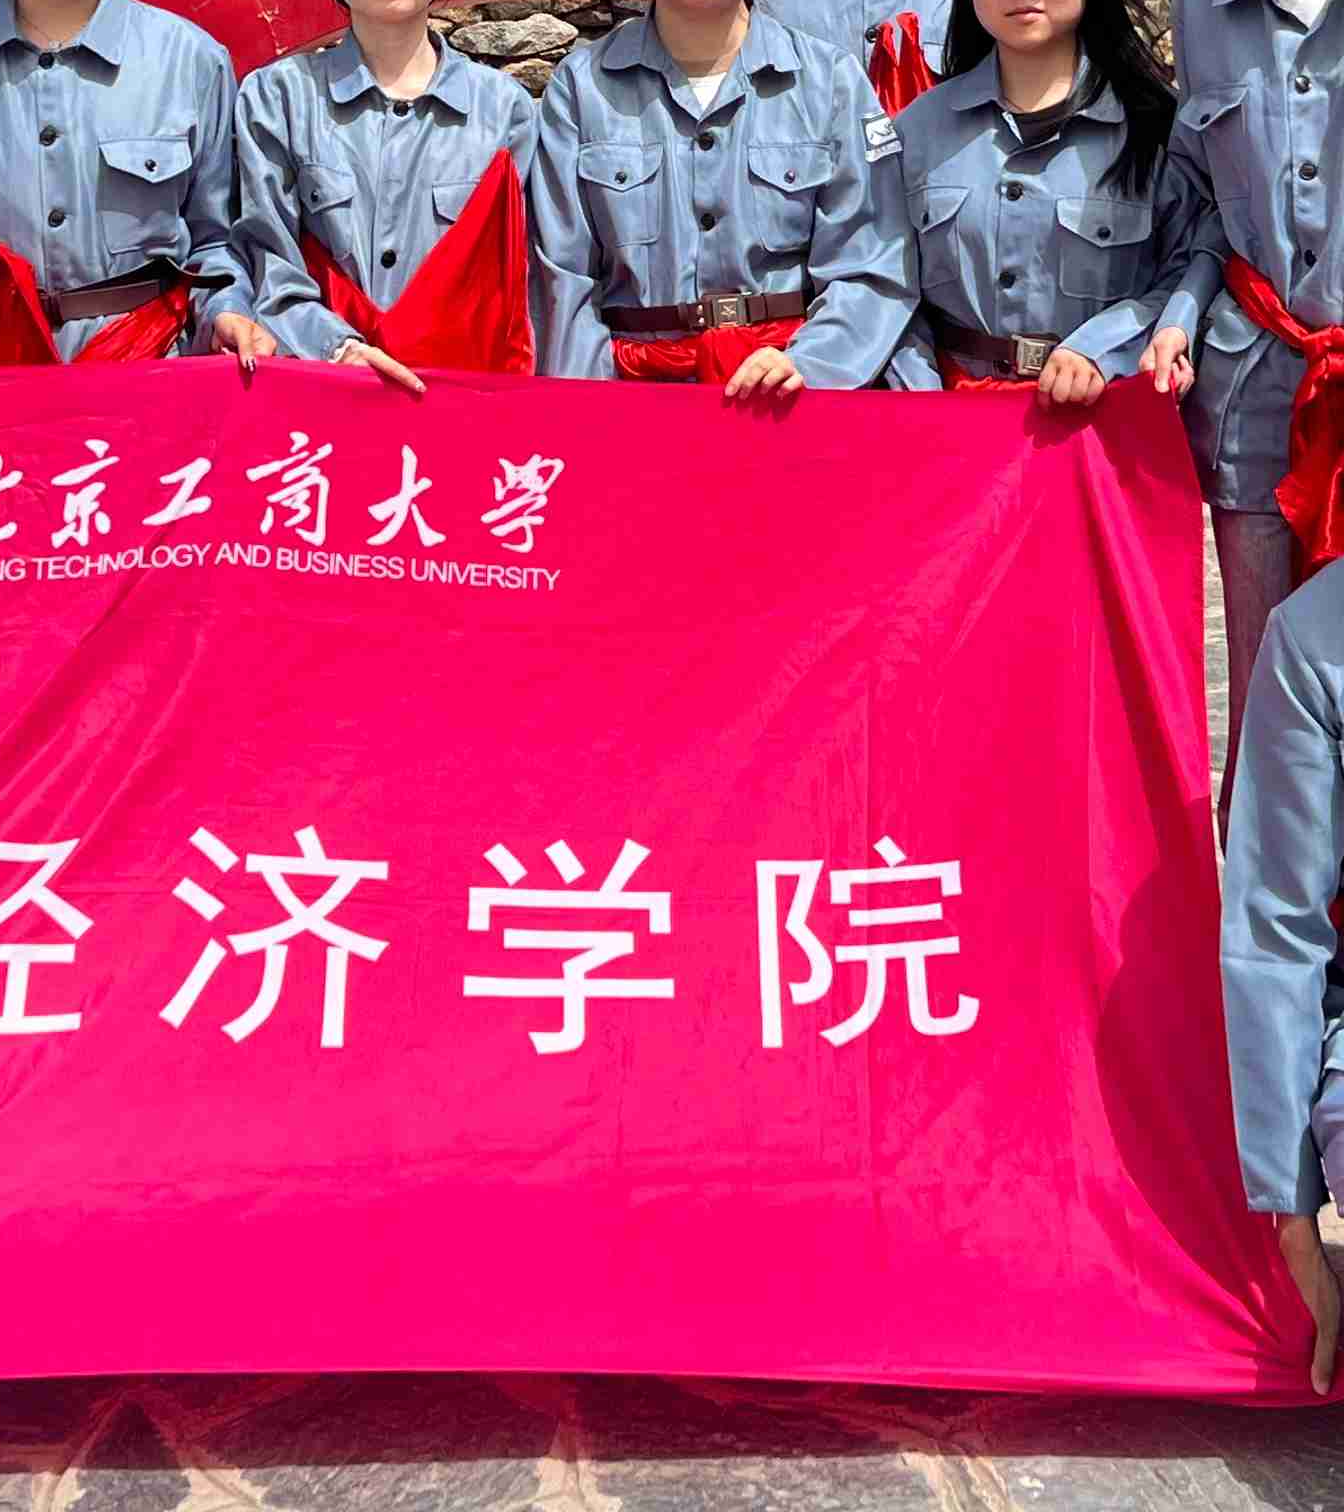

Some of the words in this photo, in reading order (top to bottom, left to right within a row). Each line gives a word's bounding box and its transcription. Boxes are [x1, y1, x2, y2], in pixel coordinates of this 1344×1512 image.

[32, 542, 211, 580] TECHNOLOGY
[214, 542, 271, 568] AND
[275, 547, 405, 580] BUSINESS
[410, 557, 561, 591] UNIVERSITY
